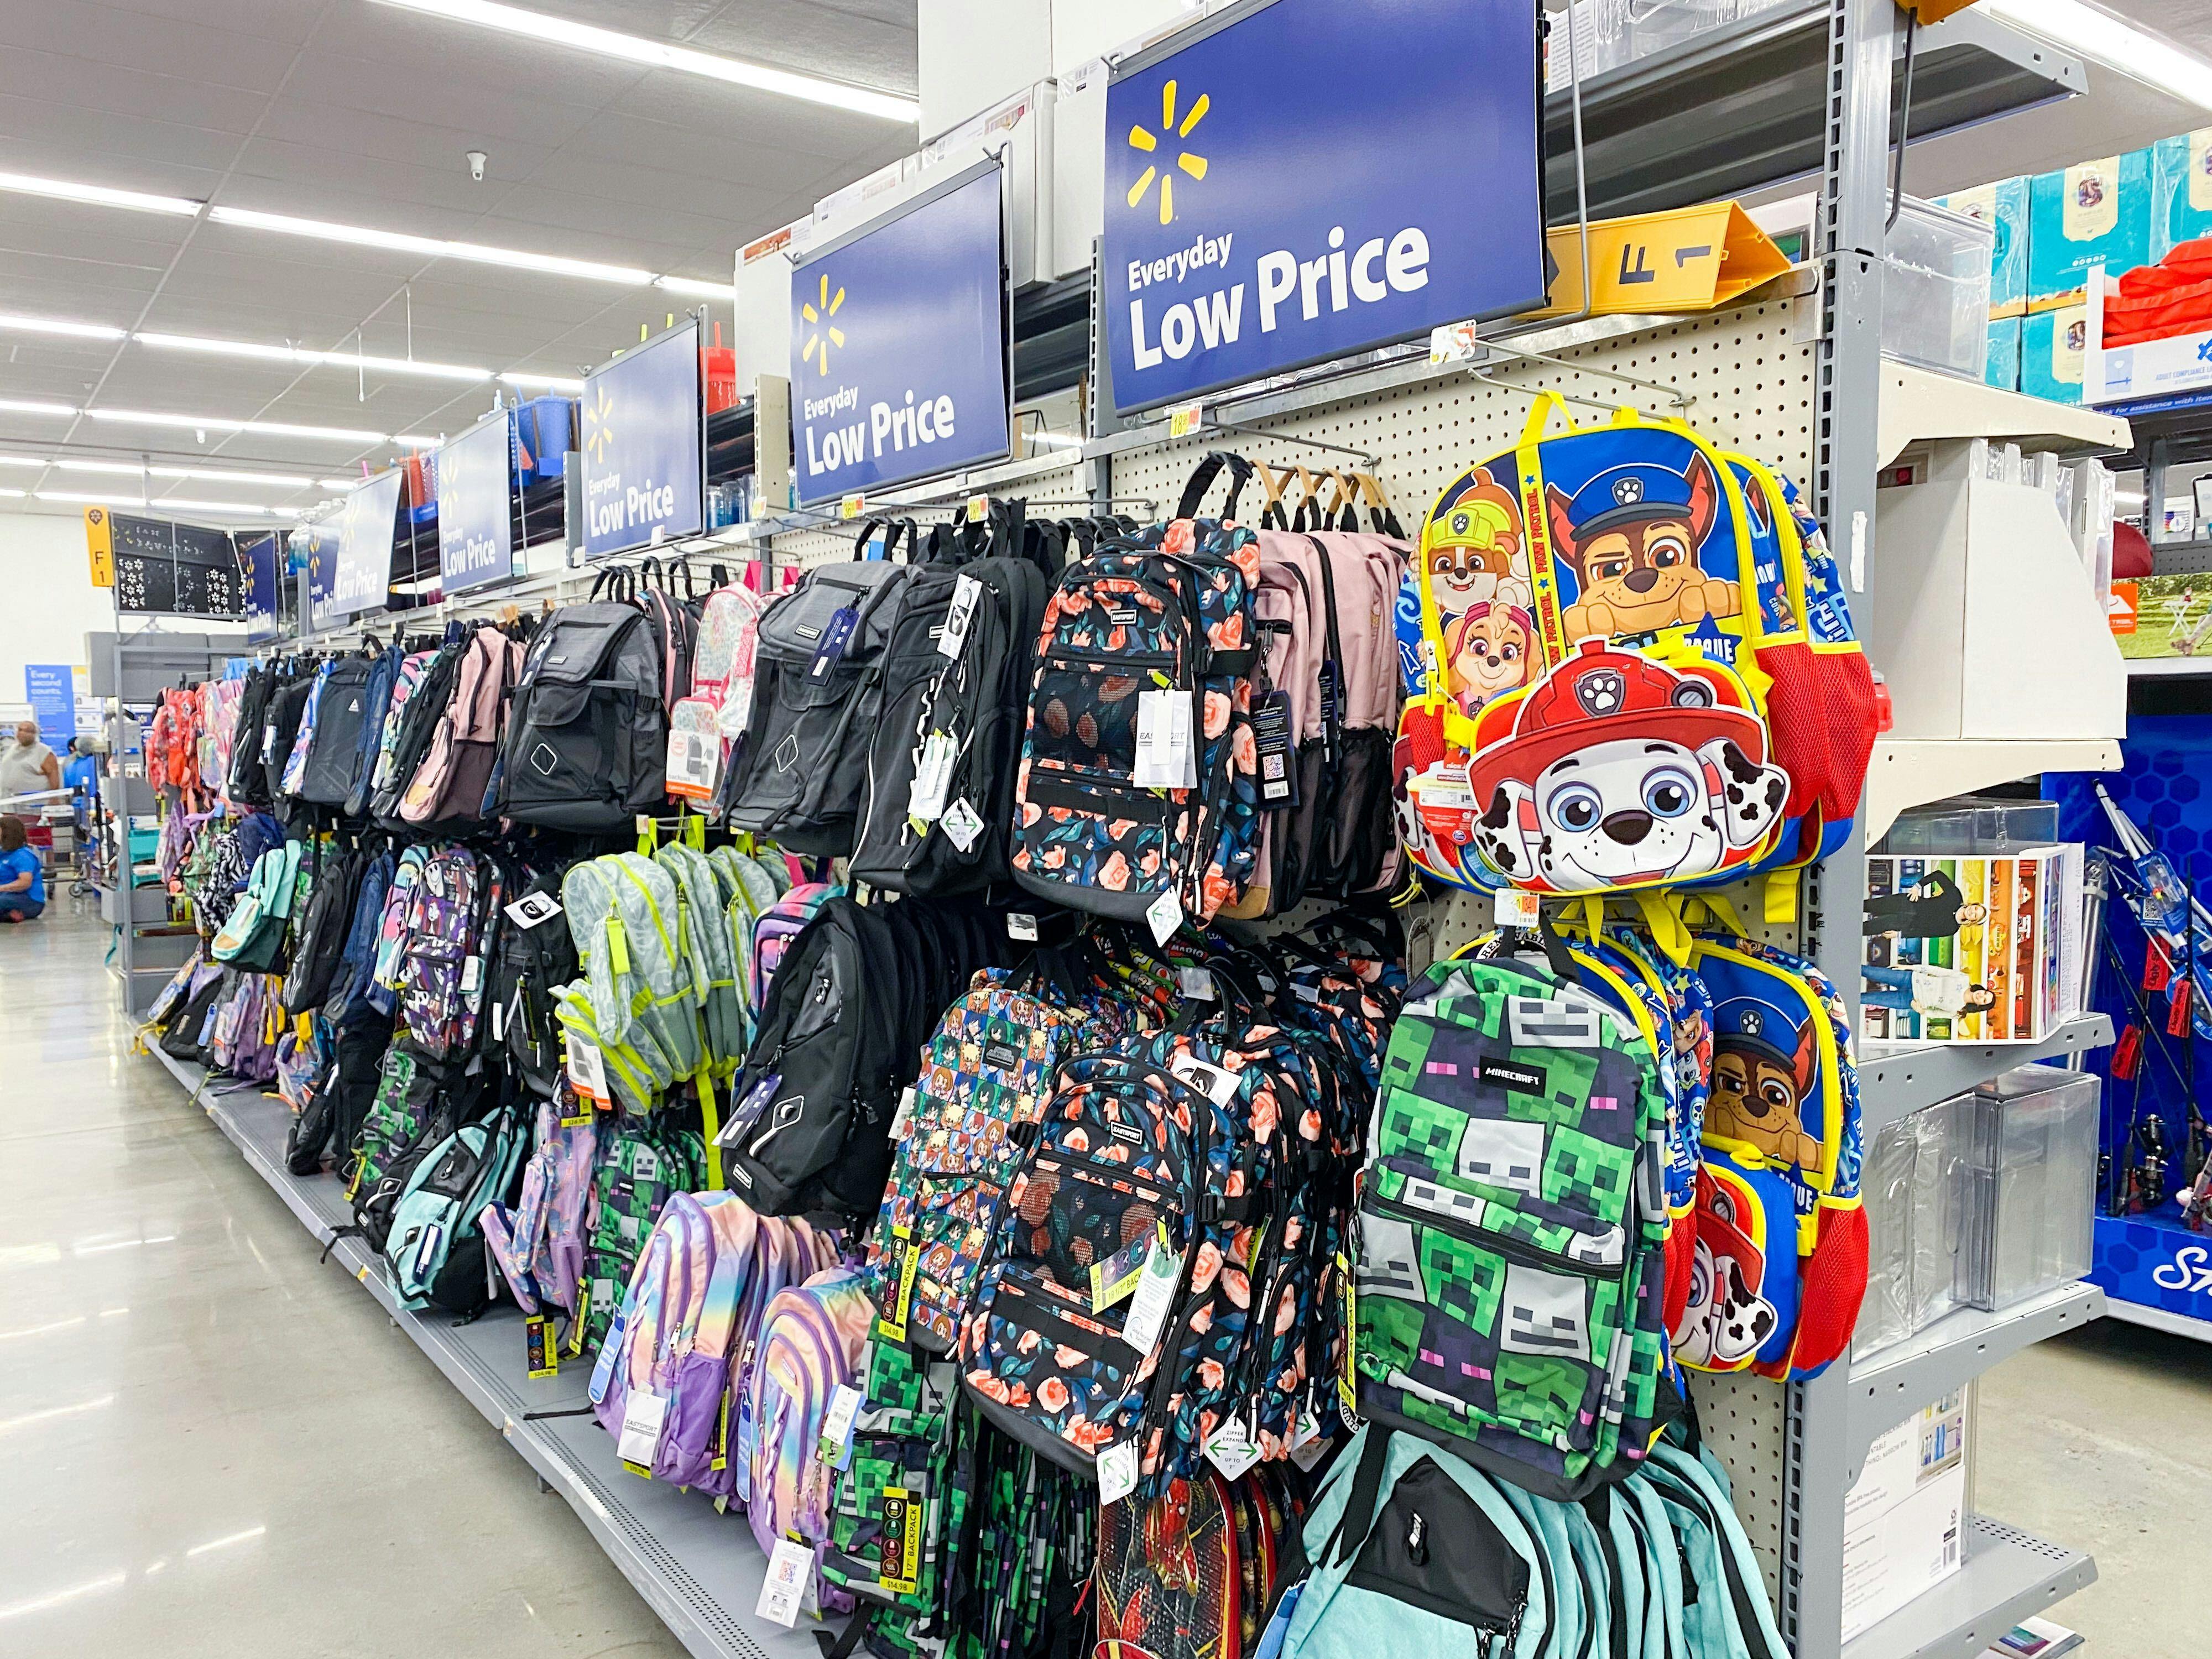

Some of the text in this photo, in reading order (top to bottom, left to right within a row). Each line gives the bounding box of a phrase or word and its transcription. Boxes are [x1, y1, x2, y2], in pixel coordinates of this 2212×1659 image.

[1128, 233, 1233, 292] Everyday
[1619, 243, 1712, 285] F 1
[1130, 226, 1431, 372] Low Price
[804, 385, 858, 421] Everyday
[2130, 400, 2173, 412] assistance
[806, 389, 954, 477] Low Price
[588, 472, 620, 495] Everyday
[589, 479, 674, 538] Low Price
[1527, 488, 1543, 539] PATROL
[95, 551, 103, 564] F
[444, 532, 495, 578] Low Price
[1532, 541, 1548, 573] PAW
[100, 571, 104, 582] 1
[337, 566, 377, 601] Low Price
[311, 598, 324, 620] Low
[1541, 591, 1558, 643] PATROL
[30, 670, 55, 680] Every
[1485, 1067, 1539, 1085] MINECRAFT
[1113, 1126, 1140, 1140] EASTSPORT
[902, 1250, 915, 1301] BACKPACK
[884, 1324, 899, 1338] $14.98
[626, 1419, 657, 1432] EASTSPORT
[908, 1508, 916, 1556] BACKPACK
[888, 1580, 907, 1590] $14.98
